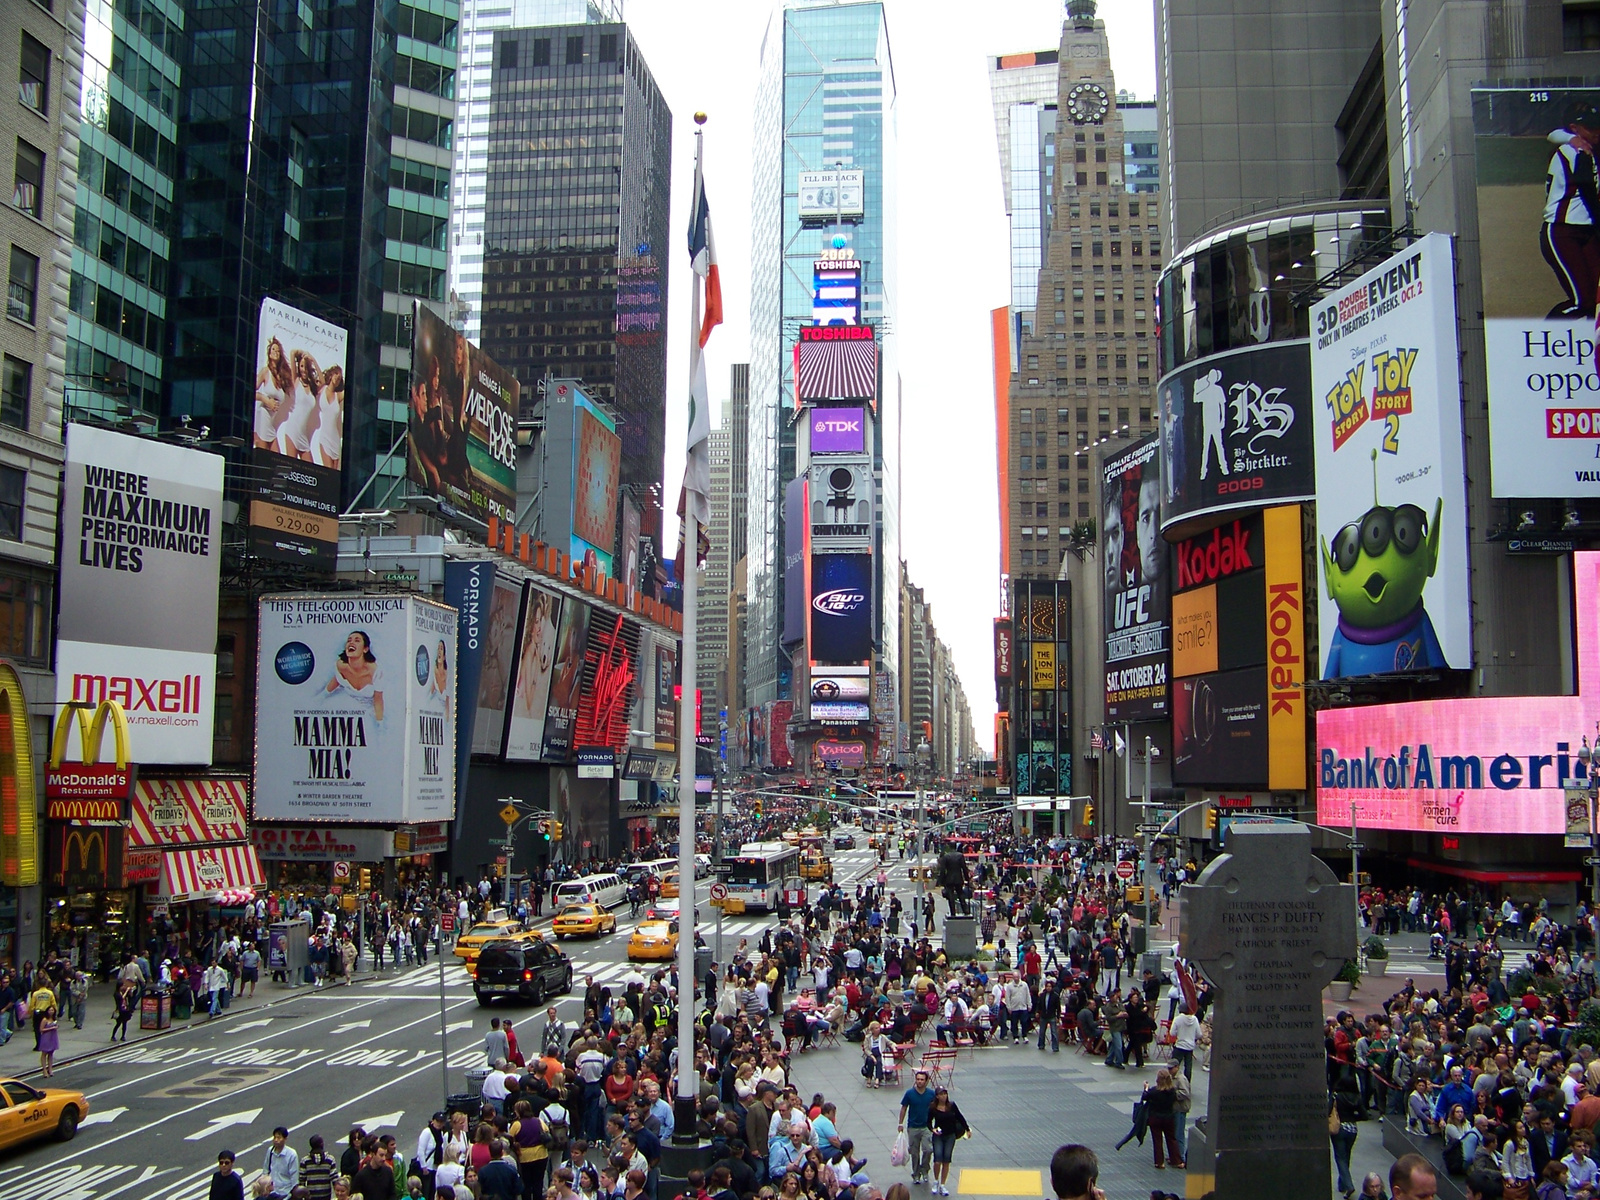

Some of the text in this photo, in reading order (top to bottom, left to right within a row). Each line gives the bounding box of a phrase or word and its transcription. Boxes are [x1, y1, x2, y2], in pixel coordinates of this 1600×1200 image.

[1530, 92, 1549, 102] 215
[821, 249, 854, 260] 2009
[814, 260, 860, 269] TOSHIBA
[1317, 252, 1421, 335] 3D DOUBLE EVENT
[1318, 281, 1422, 350] ONLY IN THEATRES 2 WEEKS. OCT. 2
[1339, 298, 1368, 323] FEATURE
[268, 306, 309, 328] MARIAH
[314, 325, 344, 342] CAREY
[801, 327, 873, 341] TOSHIBA
[1370, 334, 1387, 349] PIXAR
[1522, 328, 1594, 366] Help
[1372, 347, 1419, 394] TOY
[1326, 360, 1365, 422] TOY
[1526, 372, 1600, 399] oppo
[1375, 396, 1408, 409] STORY
[465, 388, 513, 443] MELROSE
[1334, 405, 1366, 440] STORY
[1552, 412, 1600, 434] SPOR
[825, 421, 859, 432] TDK
[1382, 411, 1400, 455] 2
[489, 432, 516, 471] PLACE
[1234, 448, 1246, 458] By
[1233, 455, 1288, 473] Sheckler
[85, 465, 148, 496] WHERE
[1218, 477, 1263, 494] 2009
[82, 487, 211, 535] MAXIMUM
[287, 494, 336, 513] KNOW WHAT LOVE IS
[275, 515, 320, 534] 9.29.09
[814, 526, 868, 535] CHEVROLET
[81, 519, 209, 556] PERFORMANCE
[79, 540, 143, 573] LIVES
[1177, 520, 1253, 587] Kodak
[297, 601, 355, 612] FEEL-GOOD
[359, 600, 405, 611] MUSICAL
[828, 594, 864, 602] BUD
[468, 564, 480, 650] VORNADO
[1115, 585, 1150, 629] UFC
[283, 613, 293, 624] IS
[296, 614, 303, 624] A
[1177, 610, 1211, 624] What makes you
[1178, 621, 1212, 651] smile?
[1108, 631, 1162, 660] MACHIDA SHOGUN
[1270, 583, 1300, 716] Kodak
[1035, 659, 1052, 670] LION
[1035, 671, 1053, 683] KING
[1107, 663, 1166, 692] SAT. OCTOBER 24
[73, 674, 201, 714] maxell
[1107, 685, 1166, 703] LIVE ON PAY-PER-VIEW
[108, 714, 199, 727] ww.maxell.com
[548, 706, 577, 719] SICK ALL THE
[293, 716, 367, 747] MAMMA
[419, 715, 443, 746] MAMMA
[819, 745, 863, 754] YAHOO!
[308, 748, 352, 779] MIA!
[424, 746, 439, 776] MIA!
[629, 760, 655, 775] VORNADO
[1321, 746, 1384, 789] Bank
[1384, 745, 1413, 789] of
[48, 774, 126, 786] McDonald's
[154, 808, 183, 820] FRIDAY'S
[207, 807, 232, 818] FRIDAY'S
[1219, 807, 1294, 815] MARQUIS
[1423, 807, 1450, 816] komen
[1437, 815, 1458, 825] cure.
[290, 844, 356, 853] COMPUTERS
[201, 867, 220, 876] FRIDAY'S
[1278, 901, 1316, 909] COLONEL
[1222, 912, 1325, 923] FRANCIS P DUFFY
[1227, 926, 1243, 934] MAY
[1235, 940, 1312, 948] CATHOLIC PRIEST
[1253, 961, 1293, 969] CHAPLAIN
[1245, 983, 1262, 991] OLD
[1236, 1004, 1312, 1013] A LIFE OF SERVICE
[1267, 1013, 1280, 1021] FOR
[1232, 1021, 1315, 1030] GOD AND COUNTRY
[1230, 1042, 1317, 1051] SPANISH AMERICAN WAR
[97, 1047, 216, 1064] ONLY
[212, 1048, 325, 1065] ONLY
[326, 1049, 443, 1067] ONLY
[1222, 1052, 1325, 1061] NEW YORK NATIONAL GUARD
